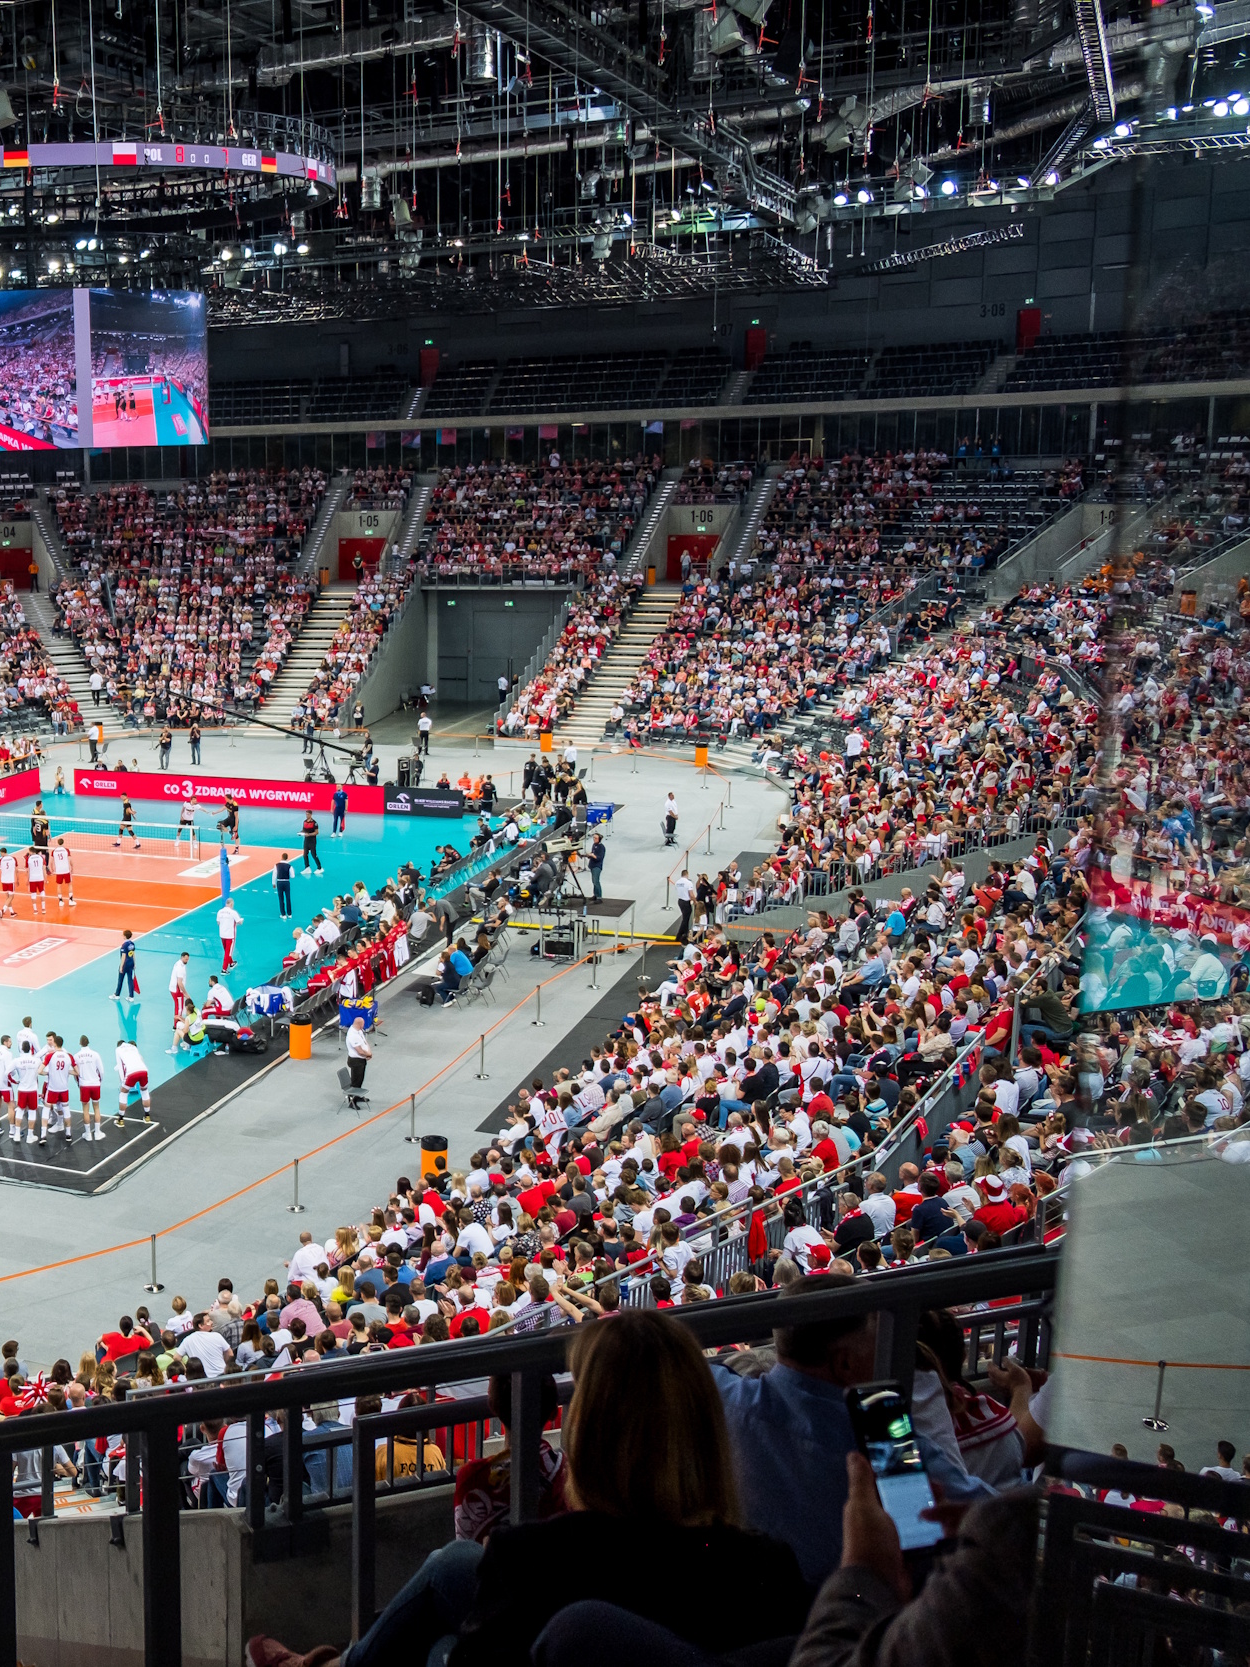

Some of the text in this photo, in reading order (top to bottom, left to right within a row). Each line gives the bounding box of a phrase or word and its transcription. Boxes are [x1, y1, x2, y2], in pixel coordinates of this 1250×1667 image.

[144, 148, 162, 162] POL
[241, 153, 256, 166] GER
[980, 303, 1006, 317] 3-08
[358, 514, 379, 527] 1-05
[691, 510, 713, 523] 1-06
[164, 784, 180, 795] CO
[181, 780, 194, 797] 3
[195, 786, 247, 799] ZDRAPKA
[388, 803, 409, 811] ORLEN
[17, 938, 62, 959] ORLEN
[56, 1060, 65, 1071] 99
[182, 1320, 193, 1332] 10
